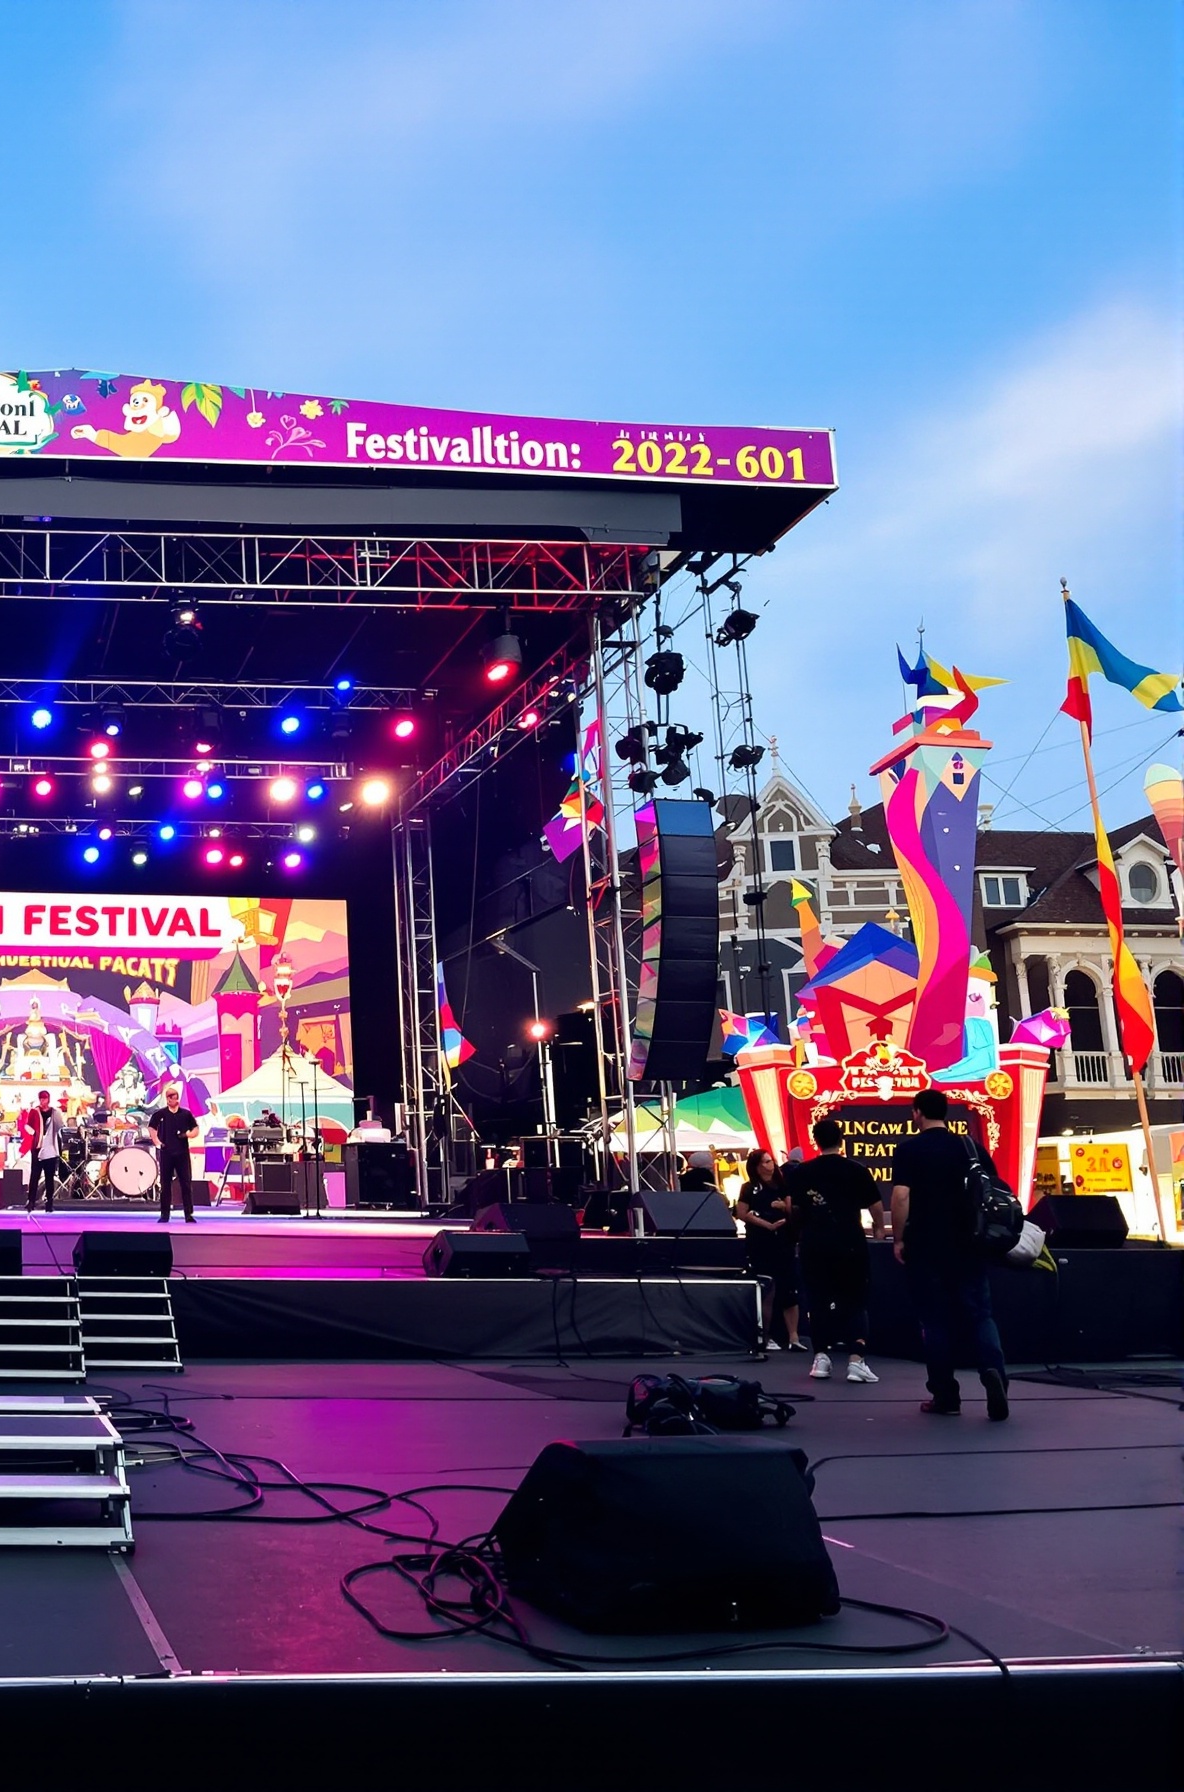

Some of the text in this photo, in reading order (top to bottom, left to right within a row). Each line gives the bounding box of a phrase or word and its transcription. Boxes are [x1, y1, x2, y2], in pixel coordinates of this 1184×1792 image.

[346, 422, 806, 481] Festivalltion: 2022-601
[23, 905, 222, 937] FESTIVAL
